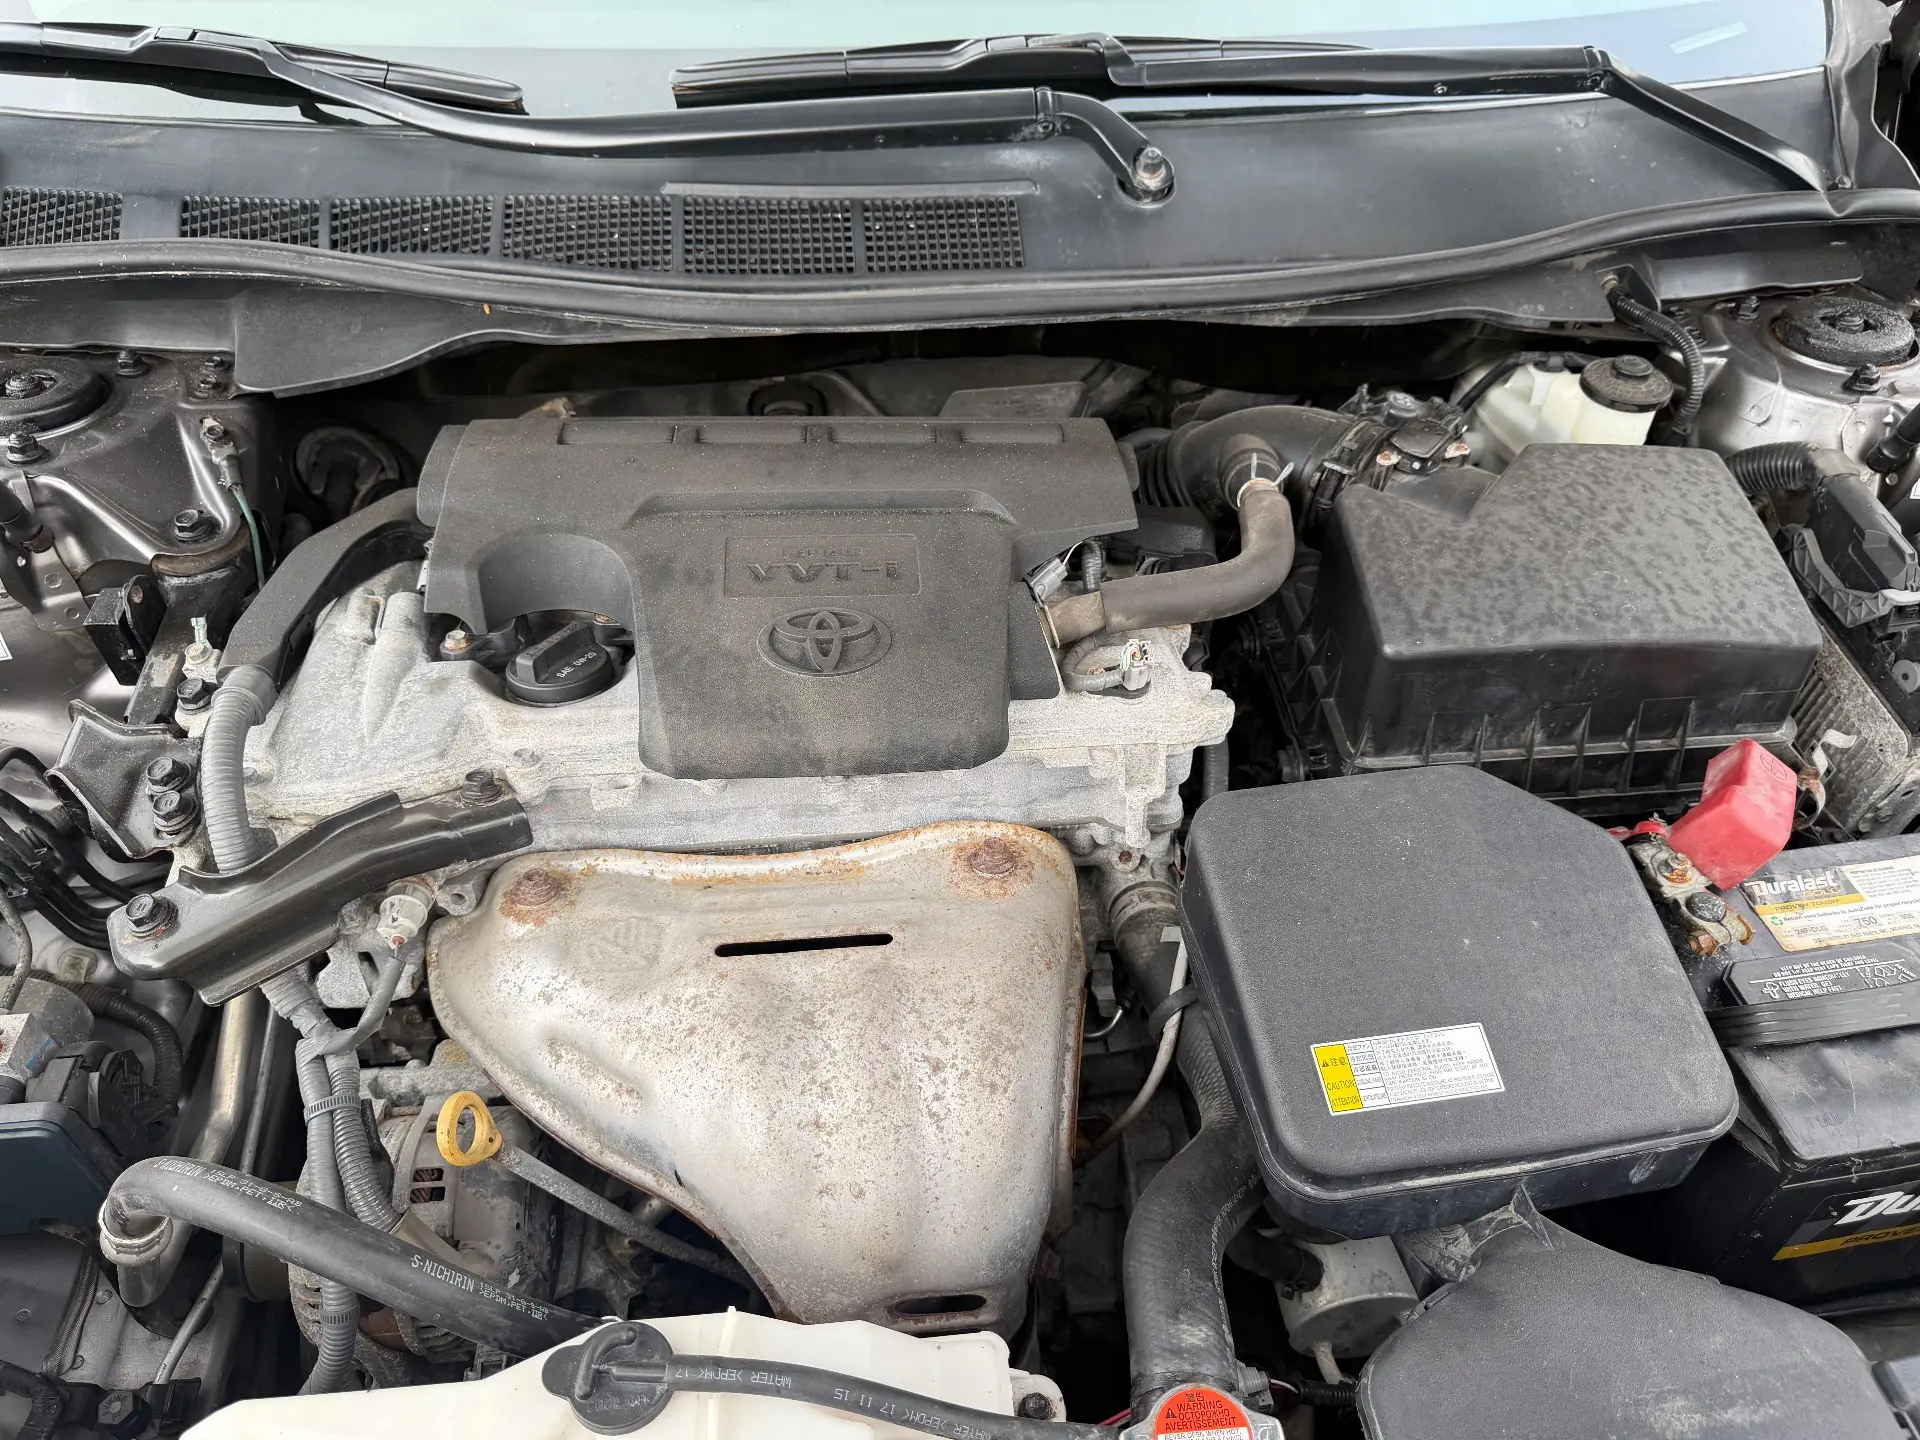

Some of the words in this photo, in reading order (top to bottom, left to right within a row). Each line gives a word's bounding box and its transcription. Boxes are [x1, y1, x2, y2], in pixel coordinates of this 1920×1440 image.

[556, 666, 575, 678] SAE
[1743, 871, 1838, 896] Duralast
[1803, 887, 1841, 898] GOLD
[1854, 916, 1878, 927] 750
[1779, 979, 1799, 987] FLUSH
[1799, 977, 1813, 985] EYES
[1786, 990, 1813, 999] MEDICAL
[1811, 987, 1829, 995] HELP
[1330, 1056, 1348, 1067] 注意
[1326, 1080, 1355, 1091] CAUTION
[1331, 1095, 1360, 1107] ATTENTION
[675, 1367, 688, 1378] 17
[751, 1371, 792, 1389] WATER
[834, 1388, 850, 1401] 15
[859, 1394, 872, 1408] 11
[1176, 1400, 1223, 1413] WARNING
[880, 1403, 896, 1416] 17
[1178, 1408, 1230, 1421] ОСТОРОЖНО
[1165, 1416, 1236, 1431] AVERTISSEMENT
[953, 1424, 991, 1440] WATER
[1186, 1431, 1205, 1439] OPEN
[1205, 1429, 1226, 1438] WHEN
